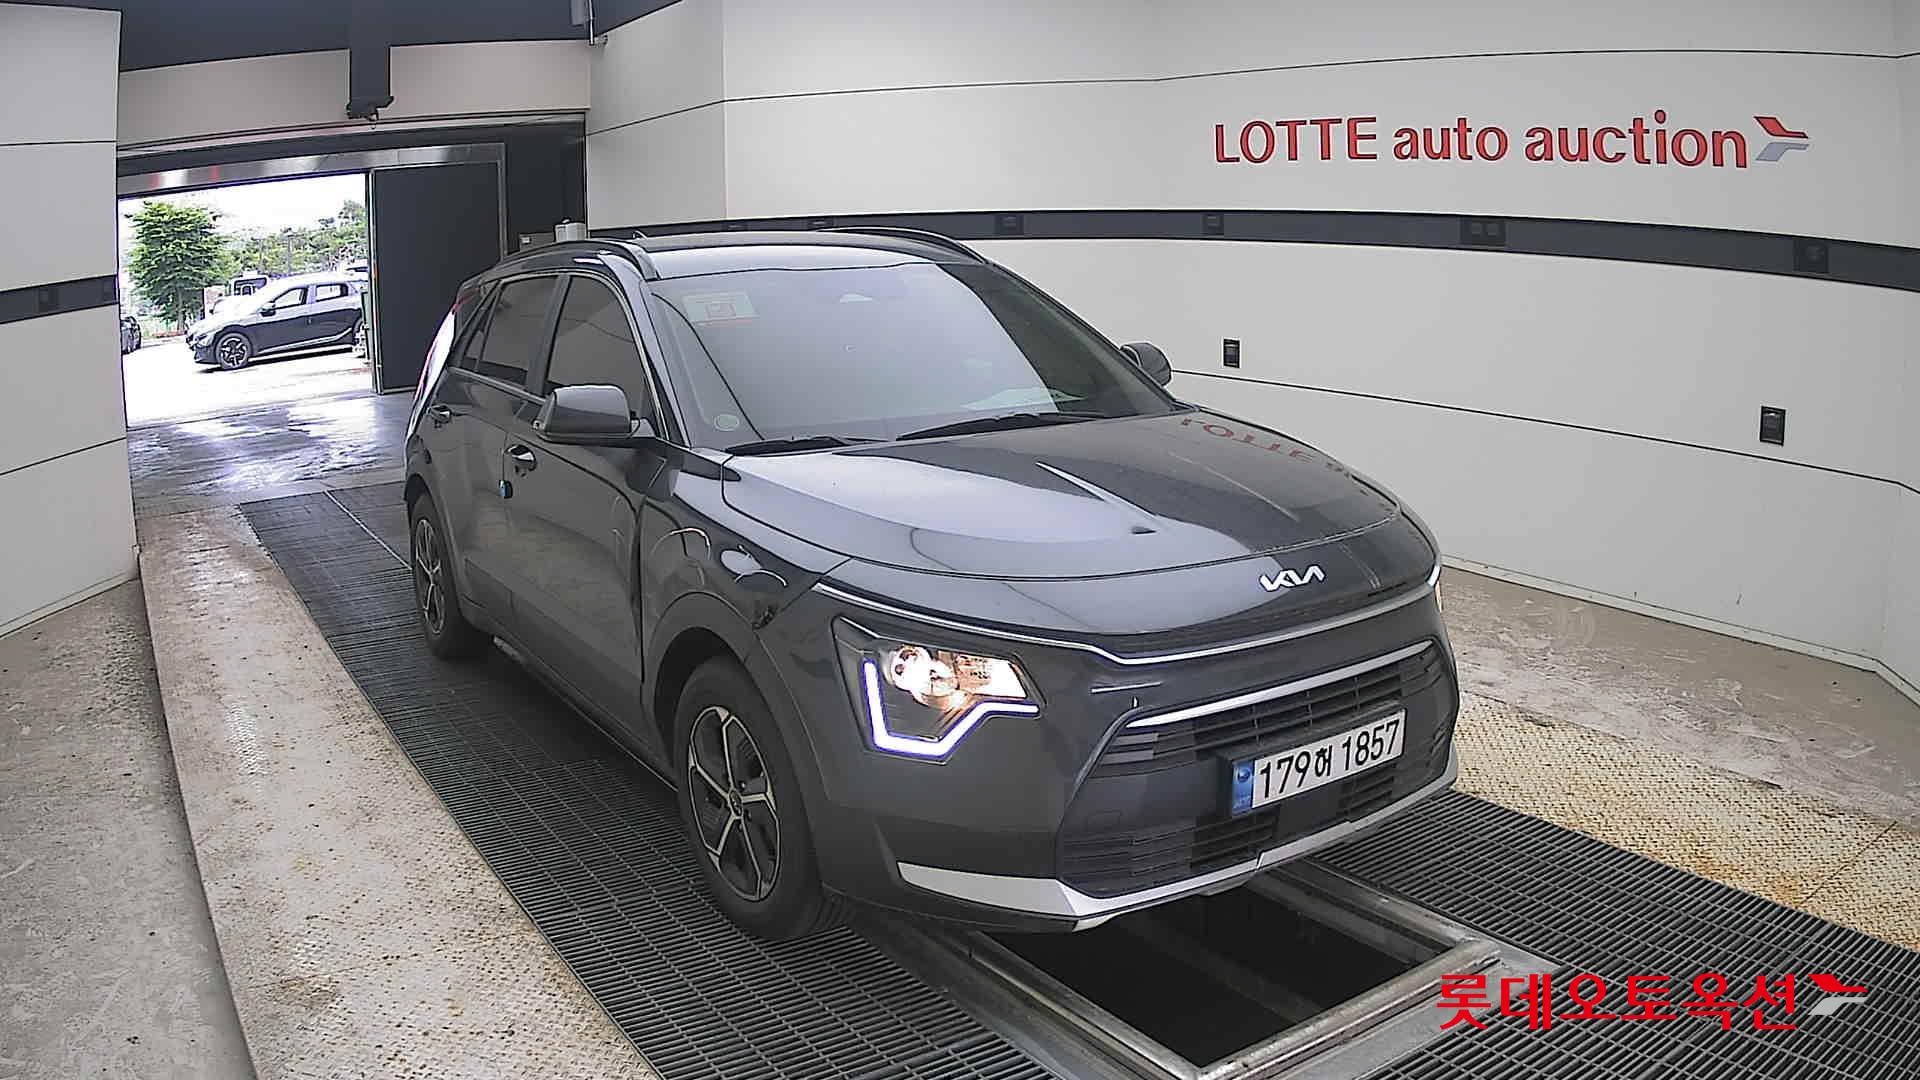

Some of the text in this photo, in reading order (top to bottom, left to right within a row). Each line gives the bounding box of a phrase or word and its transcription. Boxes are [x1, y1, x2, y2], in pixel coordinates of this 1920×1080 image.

[1215, 109, 1748, 169] LOTTE auto auction
[1259, 565, 1326, 591] KIA
[1260, 719, 1400, 799] 179허 1857
